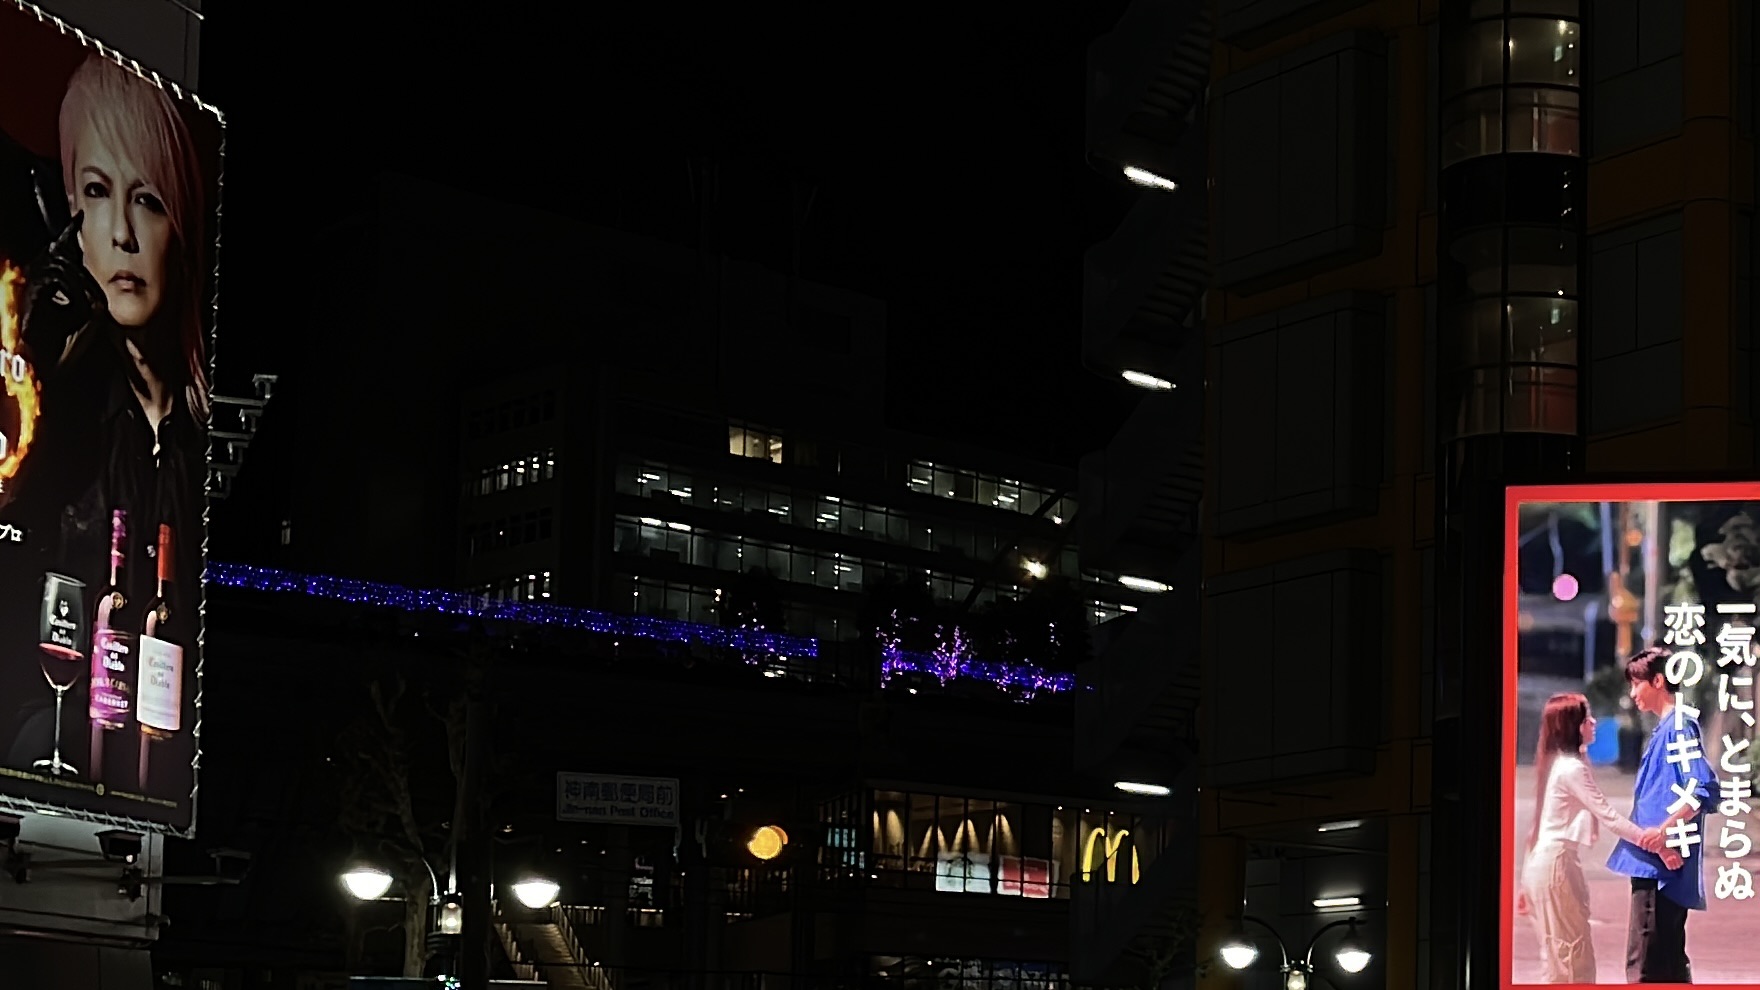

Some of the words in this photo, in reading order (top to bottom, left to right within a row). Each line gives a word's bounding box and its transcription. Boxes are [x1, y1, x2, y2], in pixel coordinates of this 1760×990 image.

[1663, 603, 1706, 859] 恋のトキメキ
[1715, 603, 1756, 901] 一気に、とまらぬ
